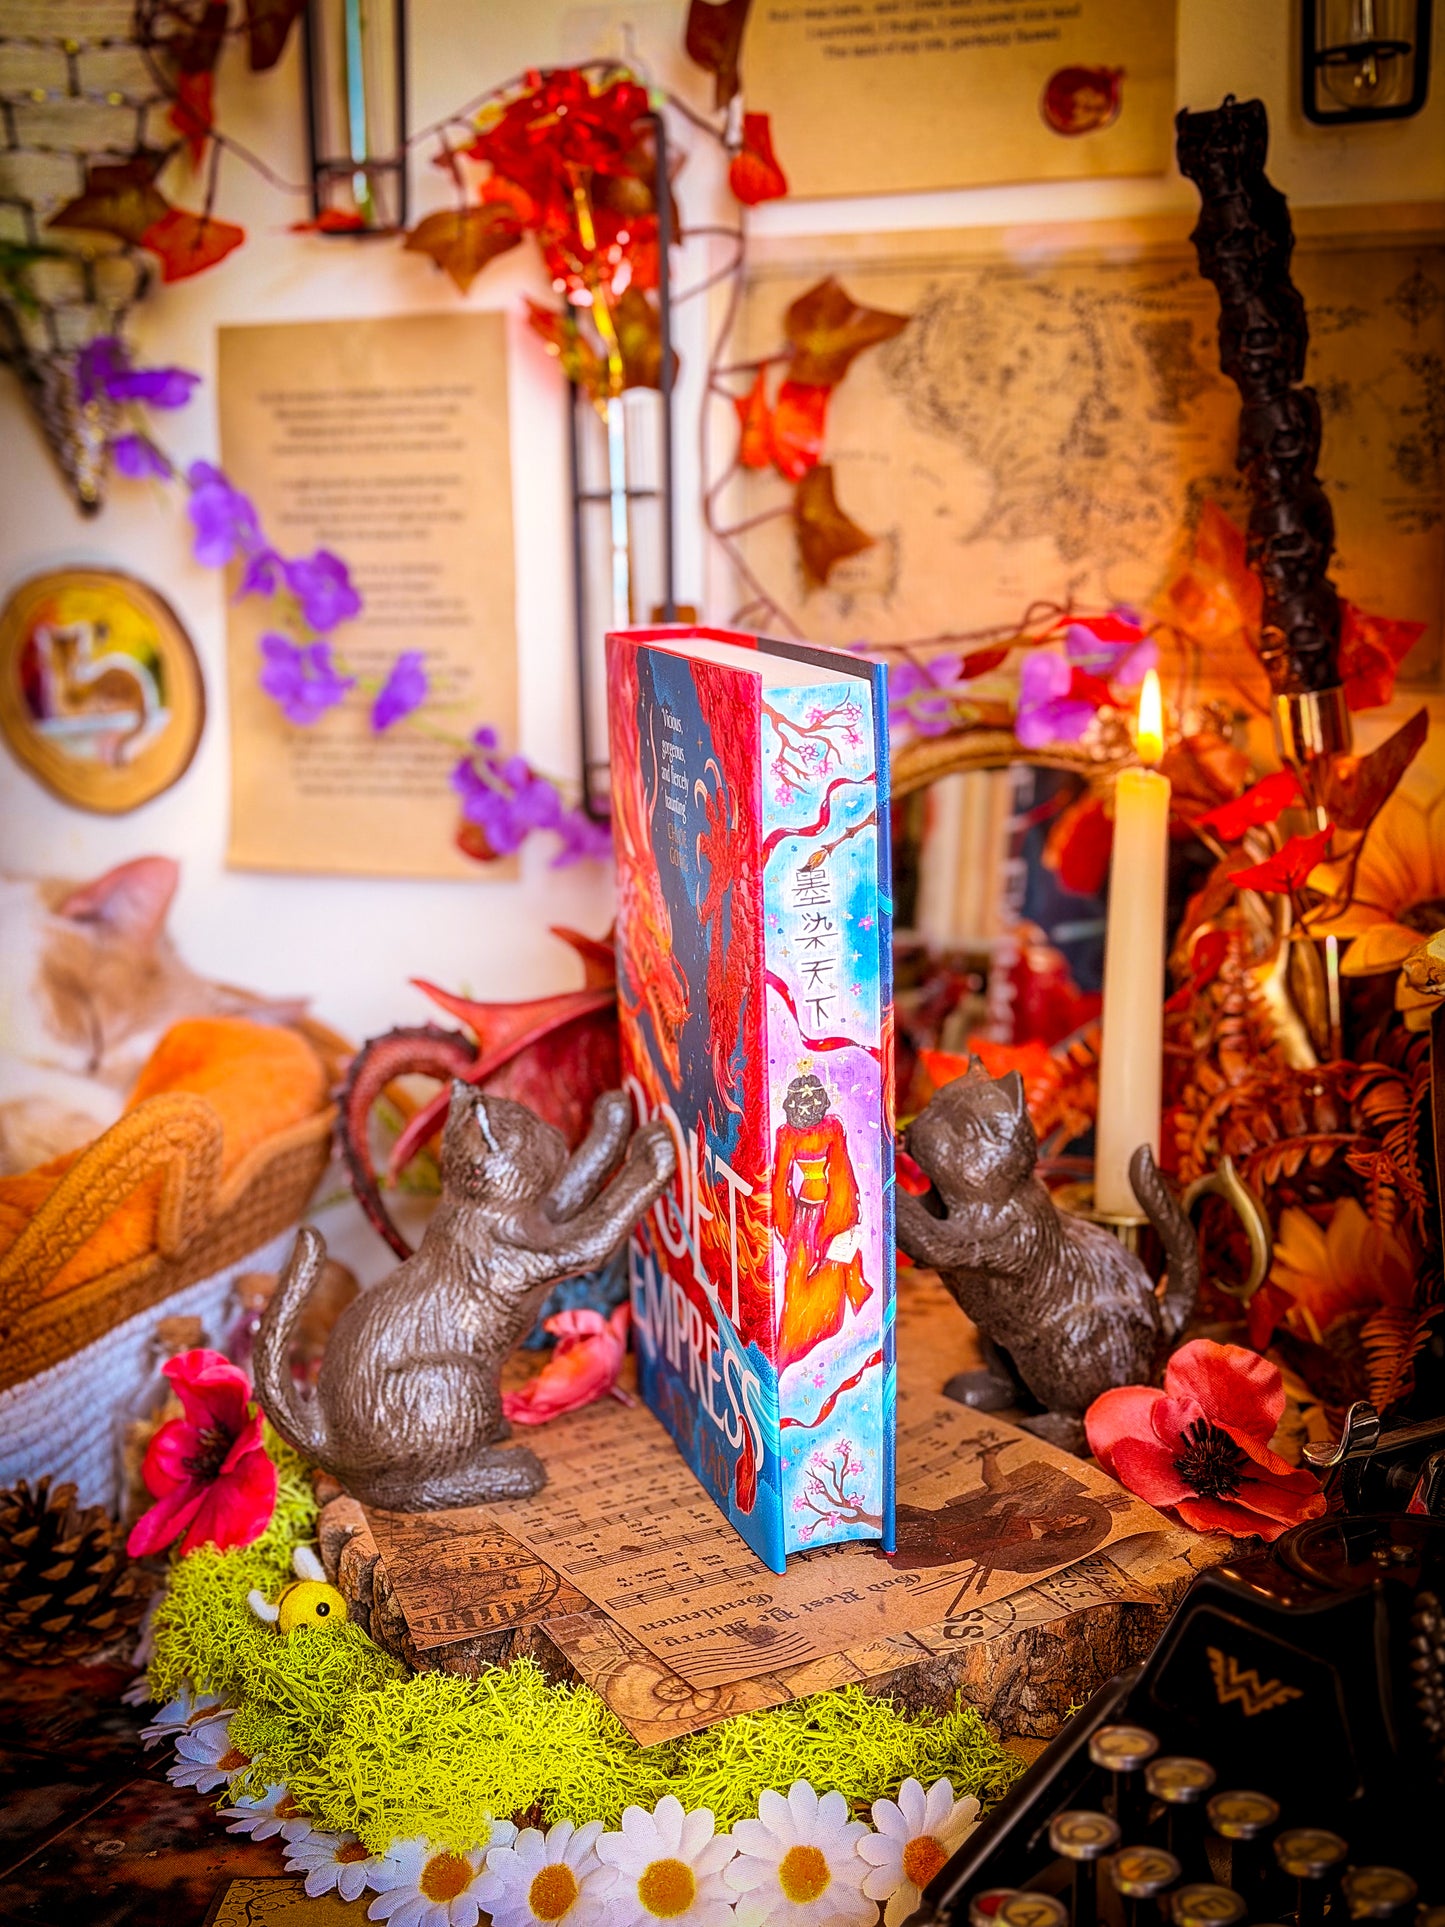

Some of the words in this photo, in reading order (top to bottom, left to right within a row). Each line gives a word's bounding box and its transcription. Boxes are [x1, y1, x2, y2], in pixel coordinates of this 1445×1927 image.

[661, 707, 684, 736] Vicious,
[661, 739, 686, 765] gorgeous,
[661, 766, 671, 783] and
[671, 765, 689, 798] fiercely
[791, 868, 839, 1028] 墨染天下
[628, 1234, 765, 1472] EMPRESS
[799, 1586, 866, 1613] Rest
[865, 1573, 922, 1594] God
[638, 1592, 774, 1632] Gentlemen
[653, 1616, 749, 1648] Merry,
